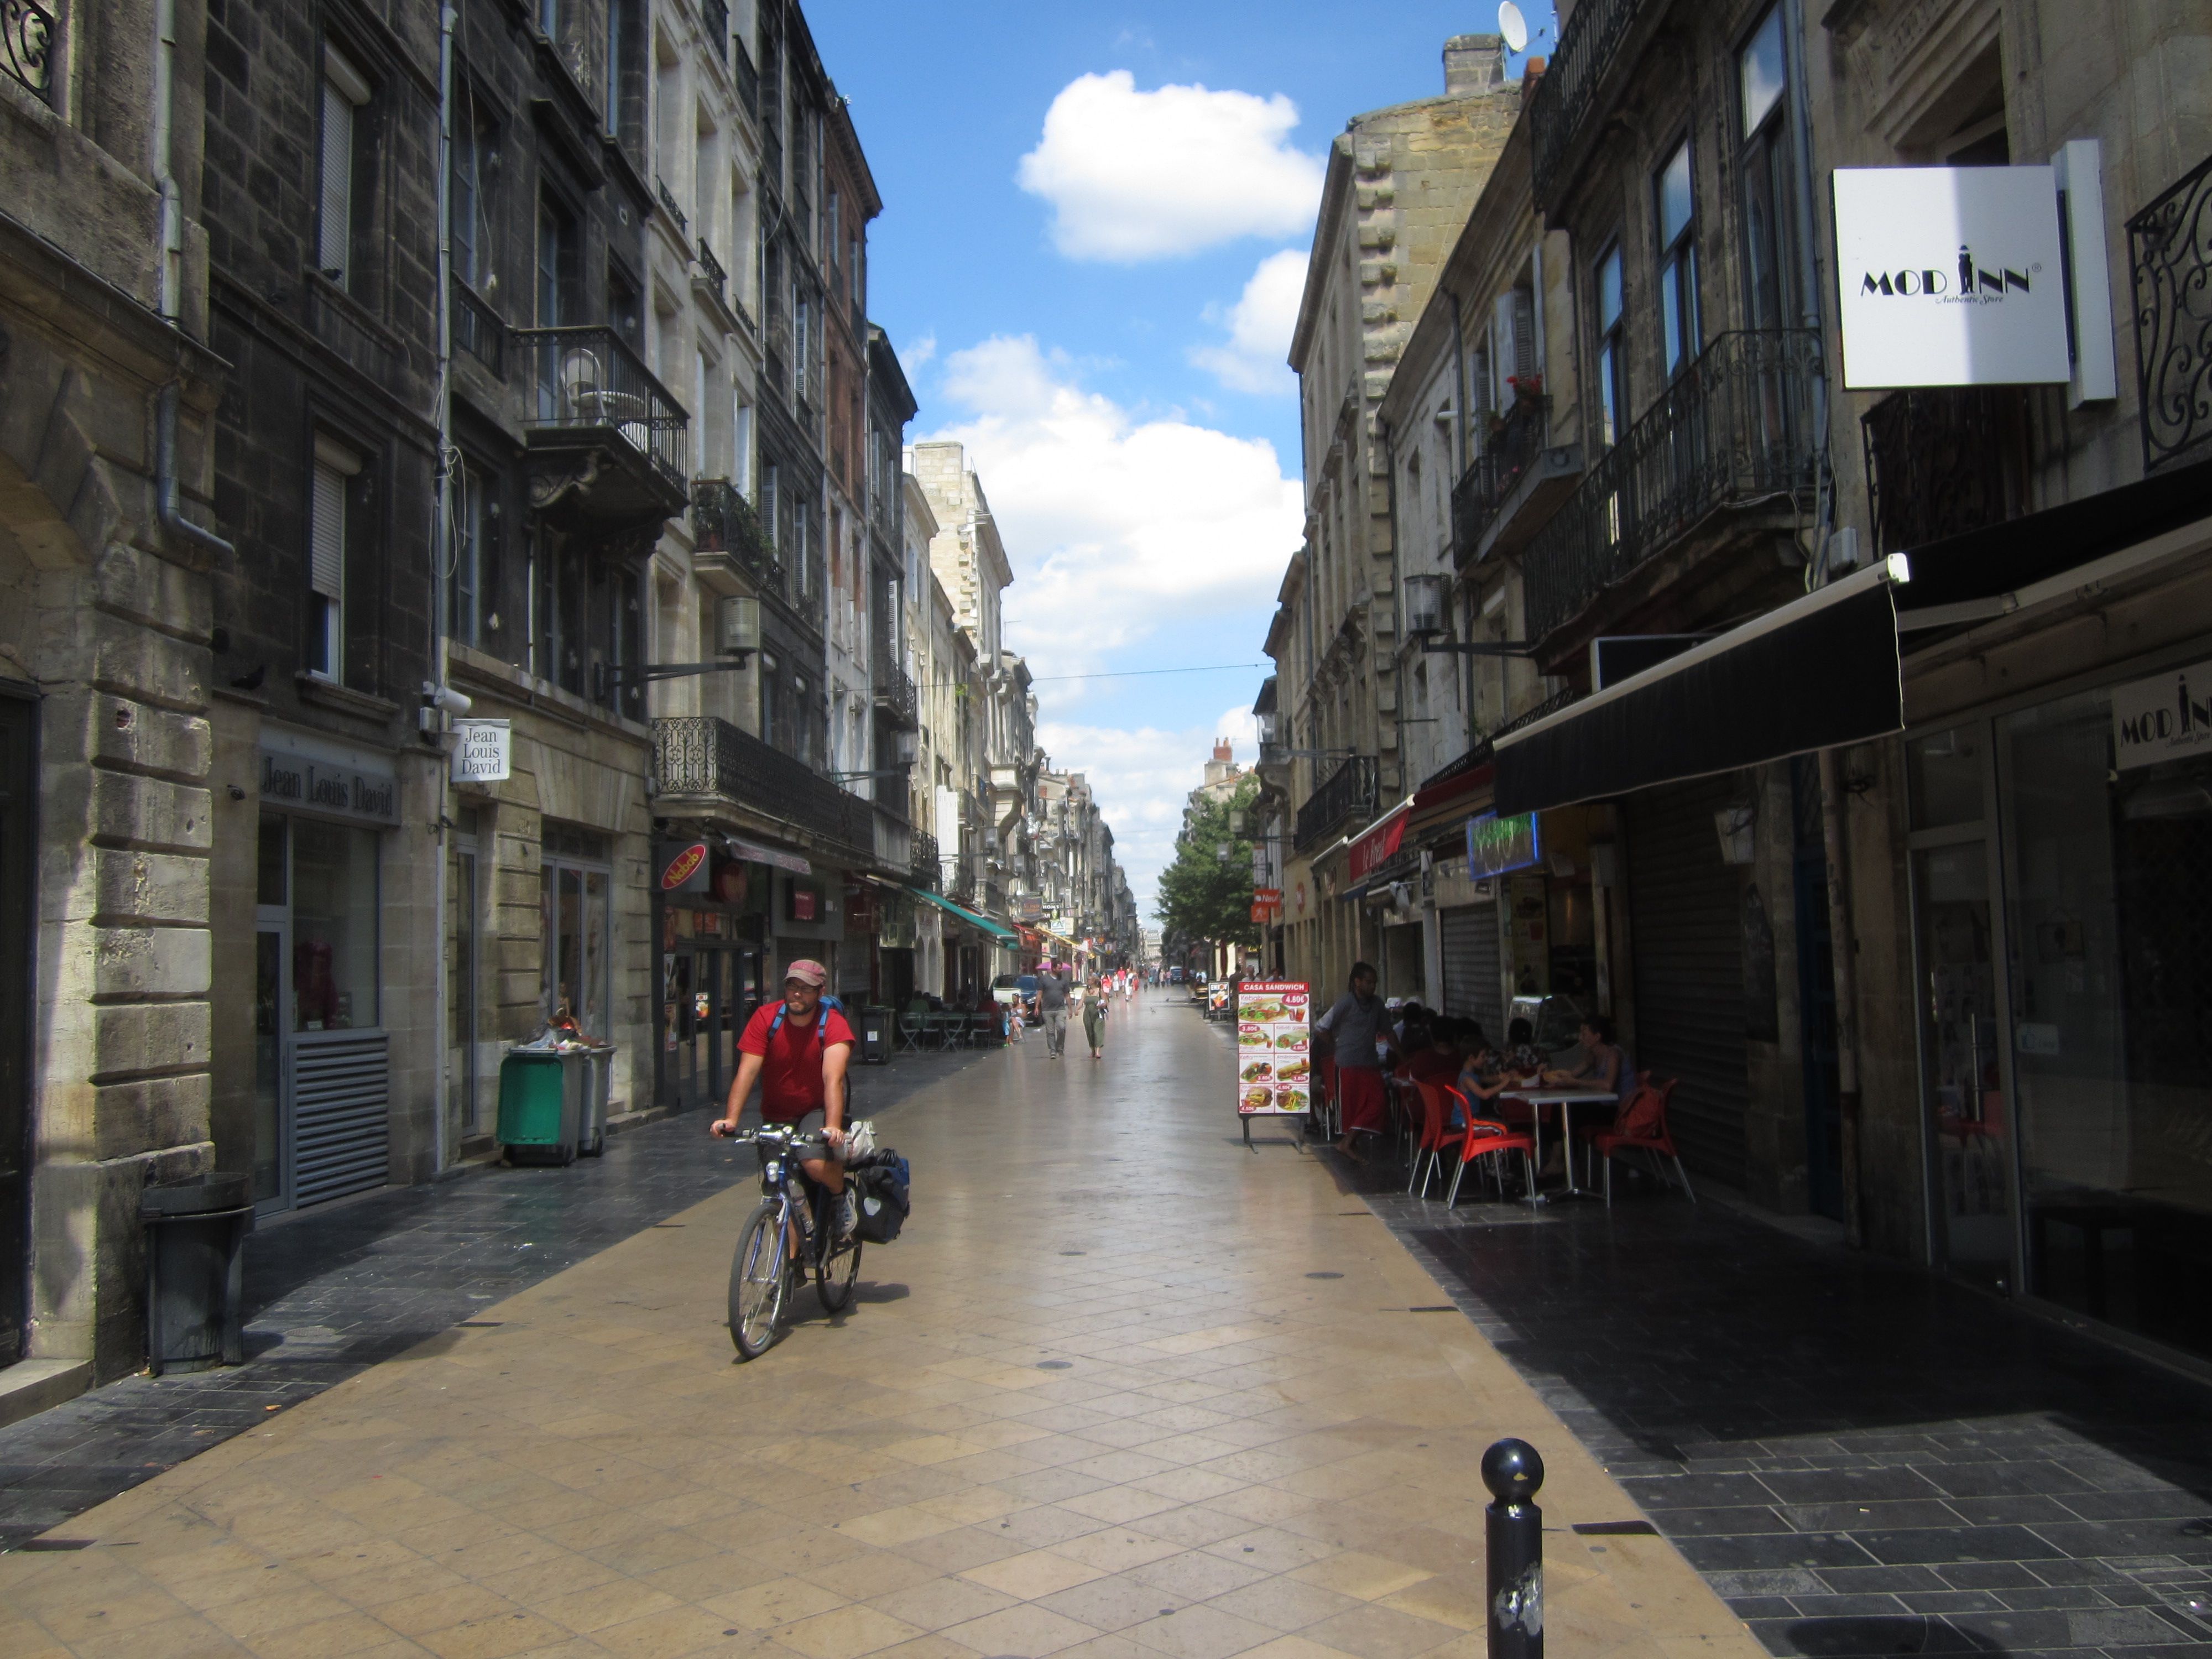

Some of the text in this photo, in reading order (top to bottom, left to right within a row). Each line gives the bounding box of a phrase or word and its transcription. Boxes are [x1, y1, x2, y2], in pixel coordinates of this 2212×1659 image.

[1860, 269, 1947, 296] MOD
[1935, 294, 2003, 305] Authentic Store
[2120, 674, 2212, 747] MOD IN
[466, 727, 497, 743] Jean
[463, 743, 500, 758] Louis
[461, 759, 500, 774] David
[262, 756, 393, 817] Jean Louis David
[667, 851, 700, 885] Nabab
[1261, 894, 1279, 903] Neuf
